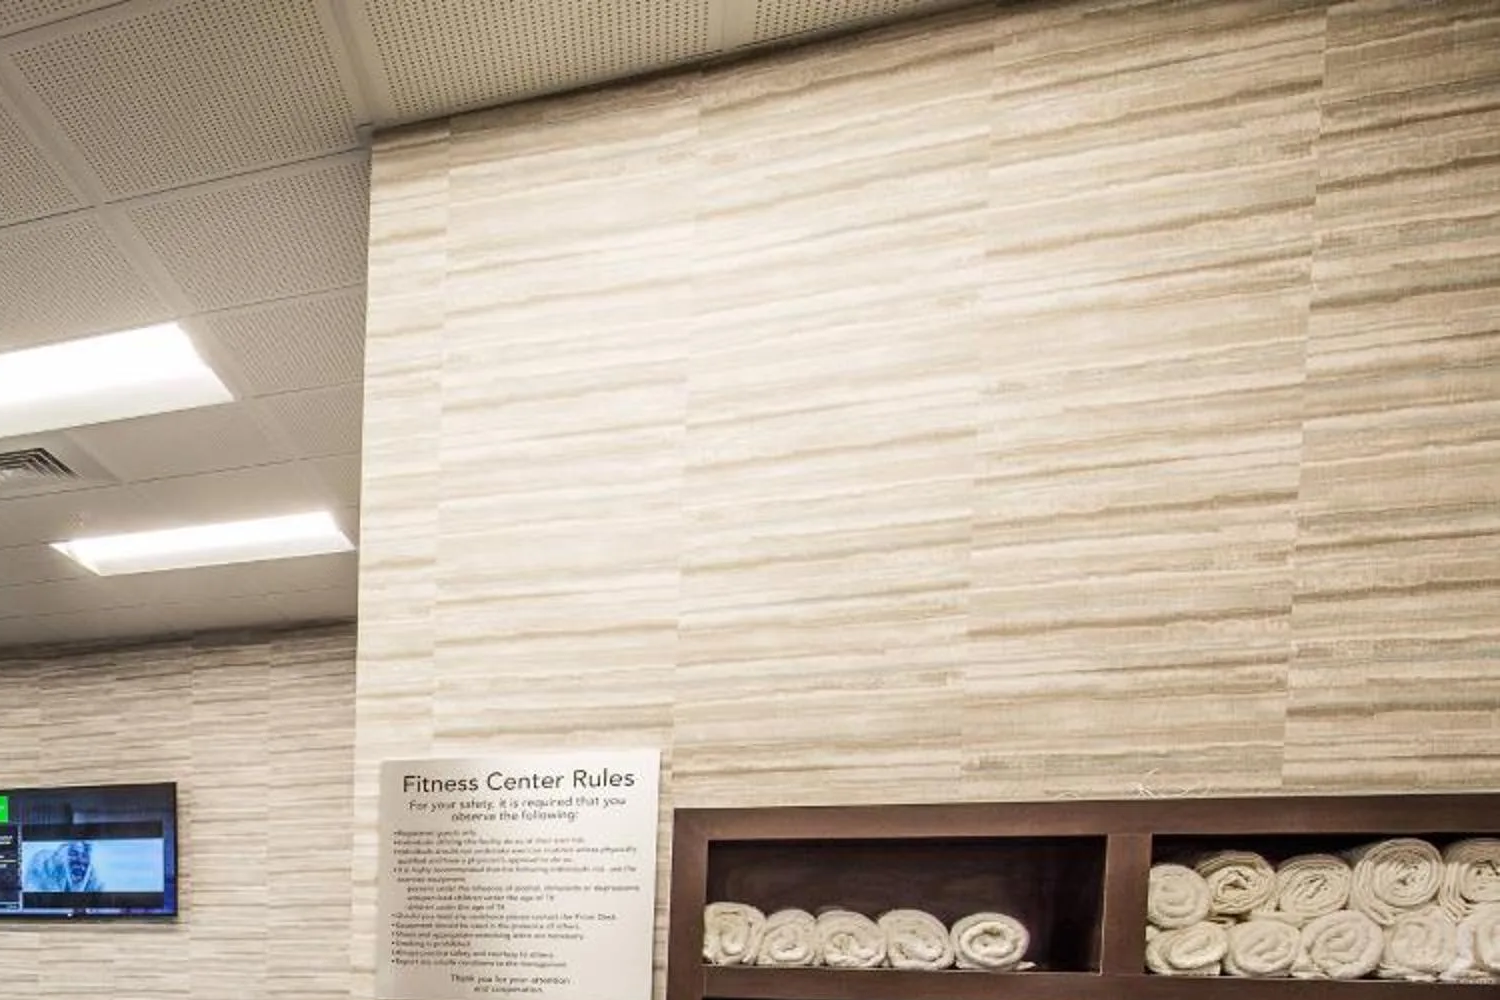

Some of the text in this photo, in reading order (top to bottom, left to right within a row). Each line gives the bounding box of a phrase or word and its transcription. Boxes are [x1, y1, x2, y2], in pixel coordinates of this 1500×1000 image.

[402, 767, 635, 793] Fitness Center Rules
[409, 799, 428, 811] For
[430, 800, 456, 813] your
[521, 796, 573, 809] required
[575, 795, 599, 806] that
[602, 797, 627, 808] you
[499, 810, 519, 821] the
